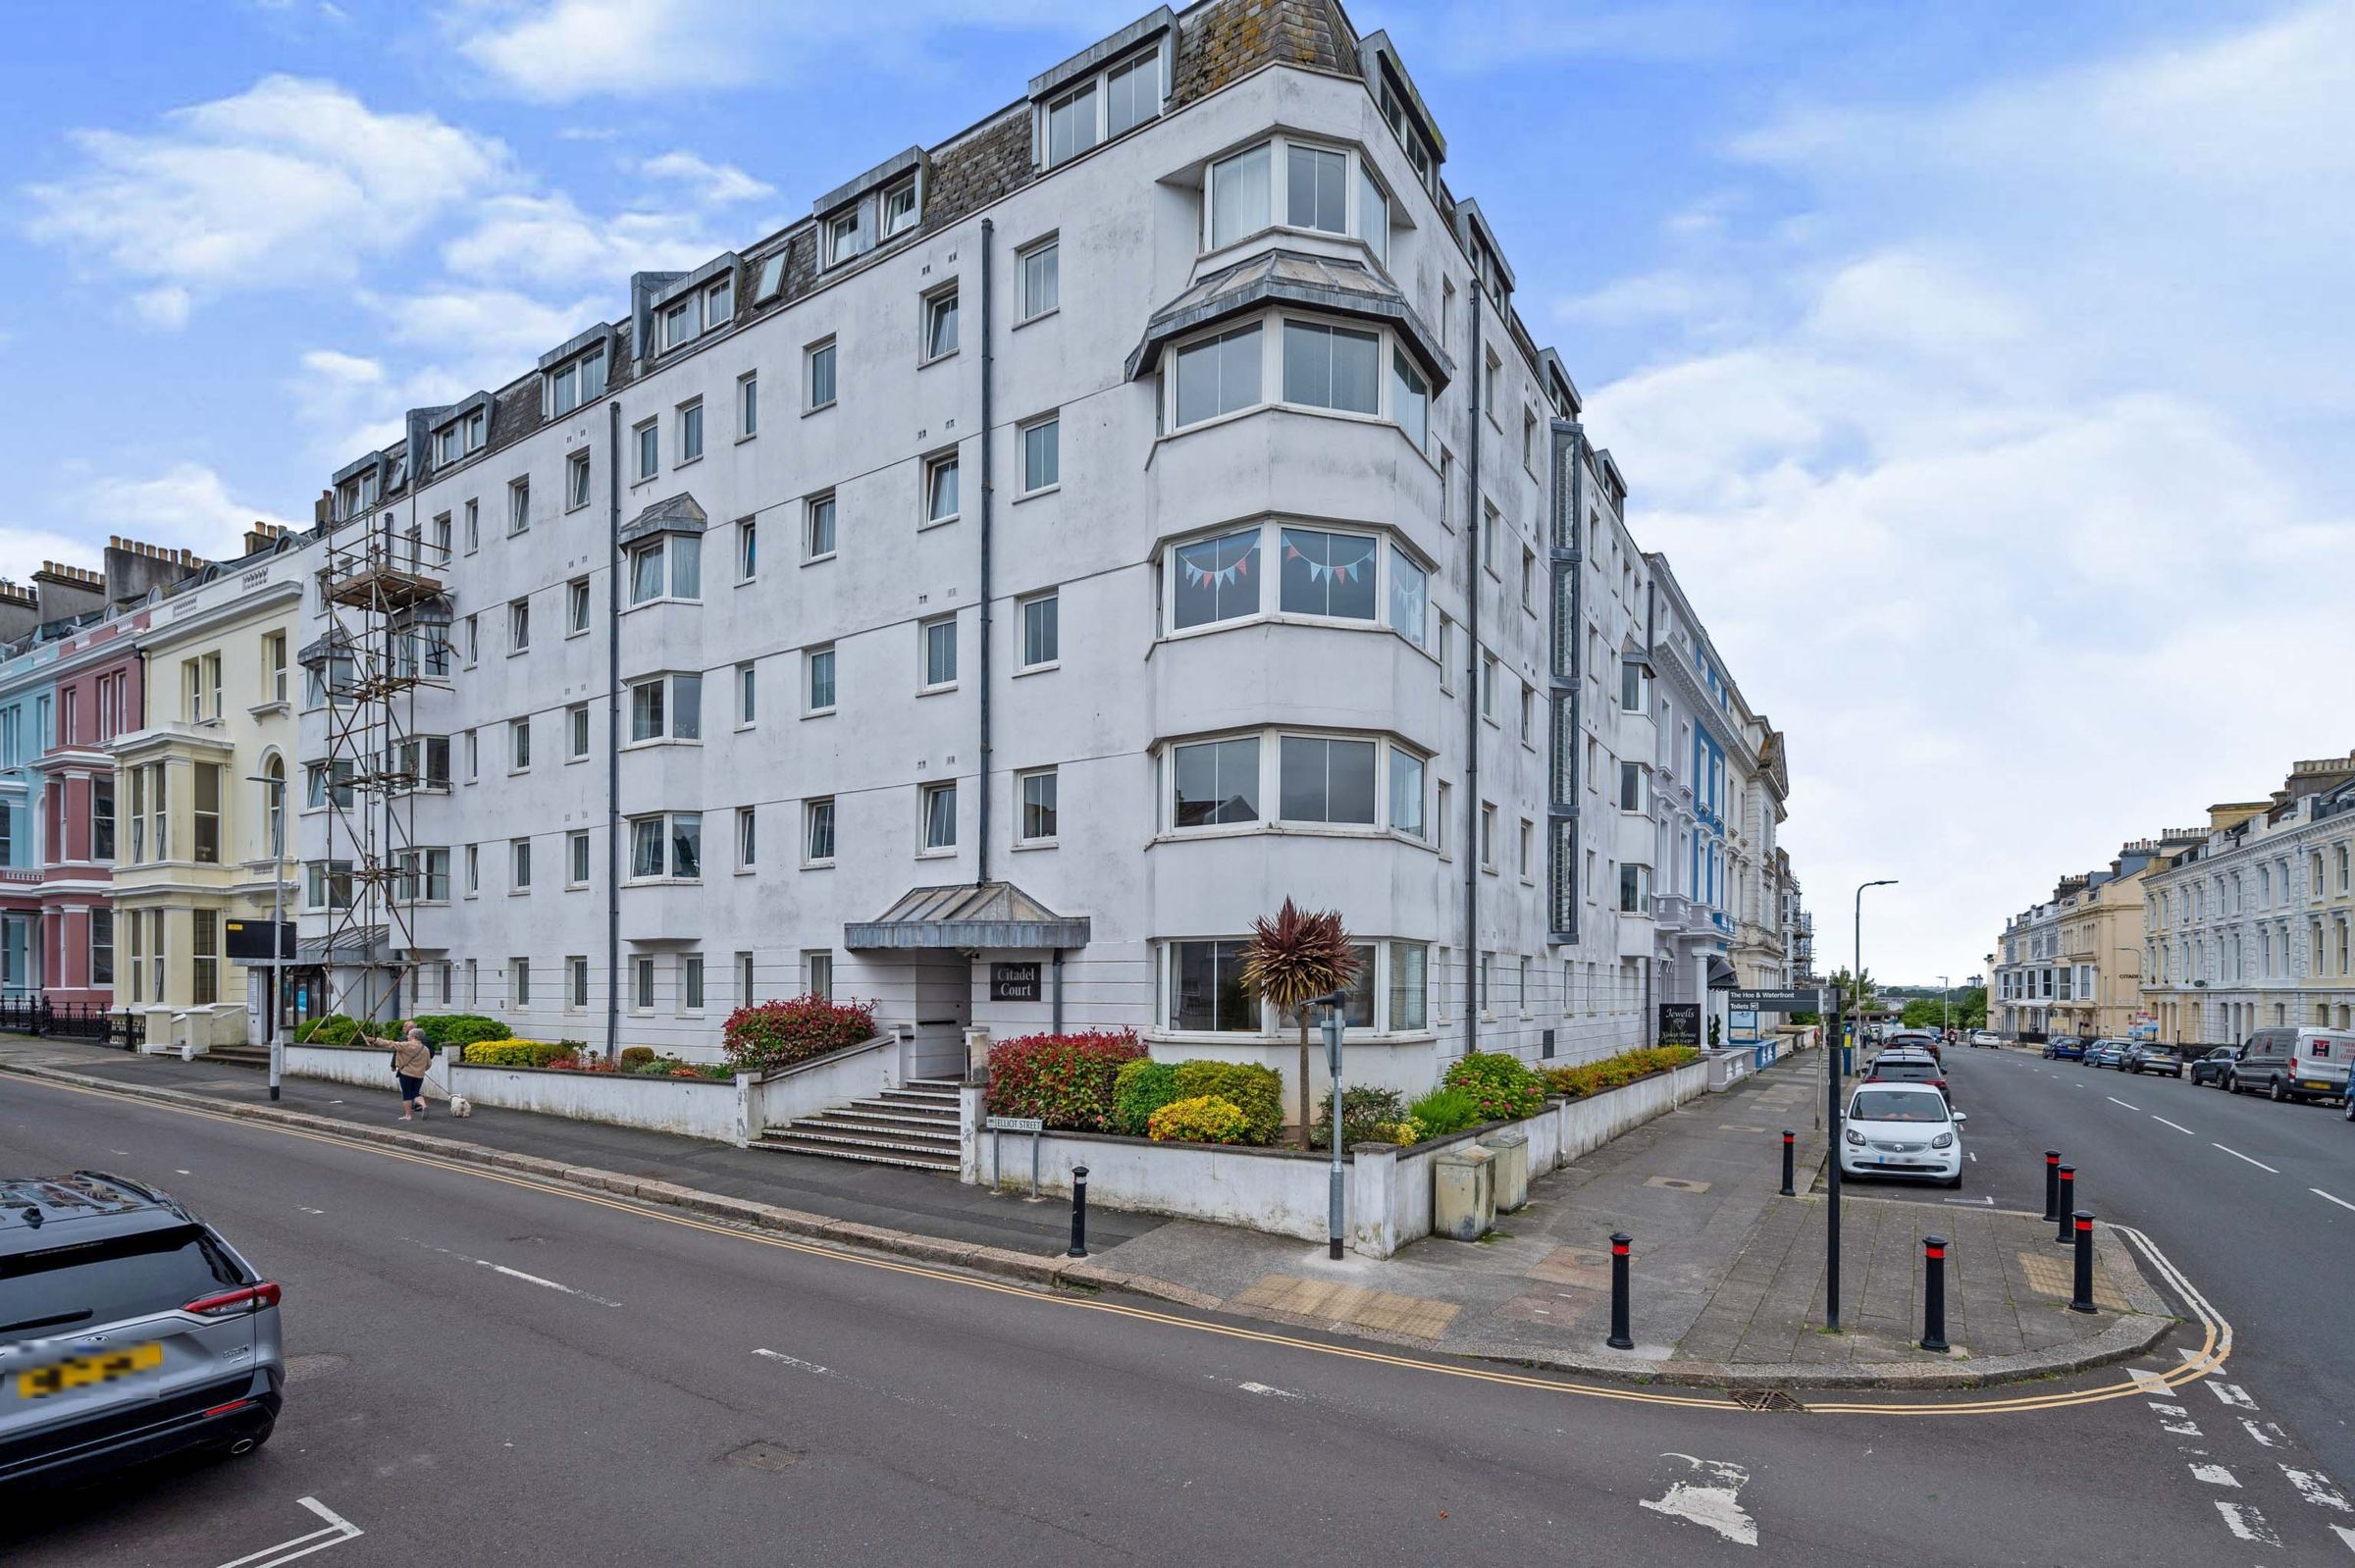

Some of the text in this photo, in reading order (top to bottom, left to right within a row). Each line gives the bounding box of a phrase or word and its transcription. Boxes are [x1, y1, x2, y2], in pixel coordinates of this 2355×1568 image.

[997, 967, 1034, 981] Citadel
[1001, 982, 1031, 997] Court
[1665, 1008, 1695, 1018] Jewells
[997, 1119, 1018, 1128] ELLIOT
[1020, 1120, 1040, 1129] STREET
